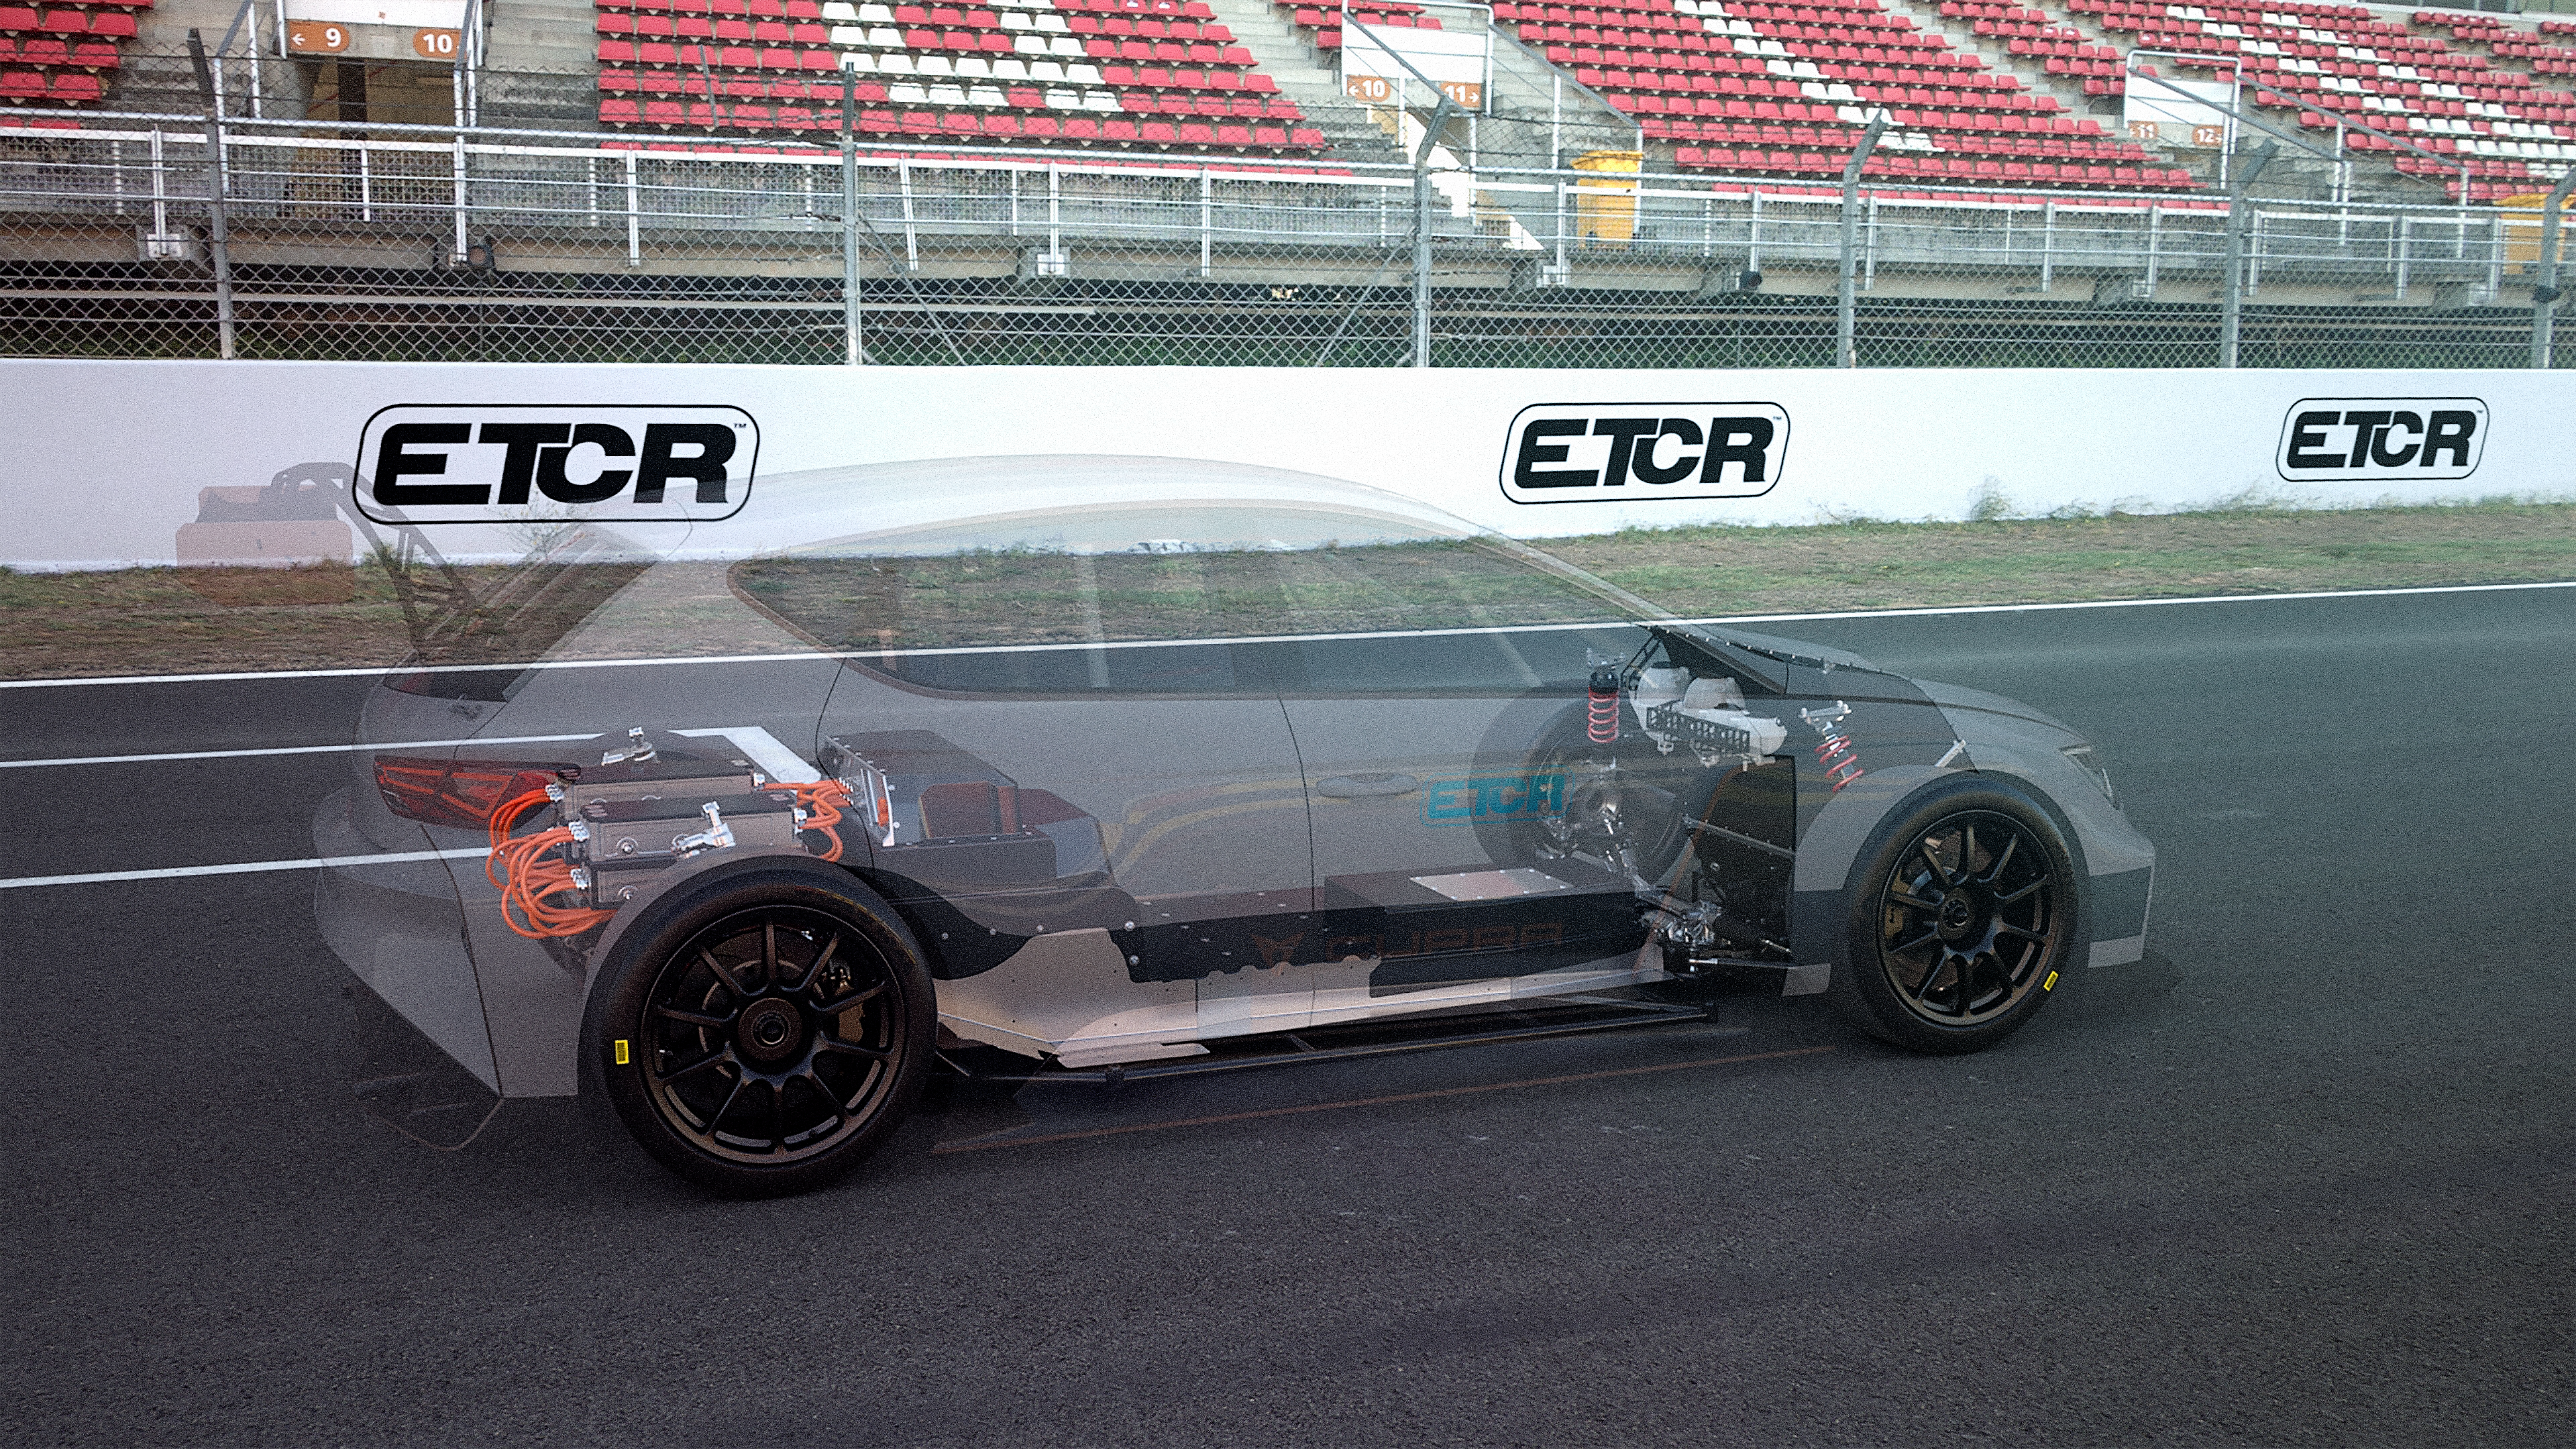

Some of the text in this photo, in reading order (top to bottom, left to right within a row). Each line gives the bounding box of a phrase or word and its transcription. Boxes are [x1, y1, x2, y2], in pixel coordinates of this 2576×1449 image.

[325, 28, 341, 47] 9
[423, 34, 453, 54] 10
[1362, 80, 1385, 97] 10
[1445, 85, 1466, 102] 11
[2138, 123, 2154, 138] 11
[2197, 128, 2215, 143] 12
[2286, 410, 2477, 469] ETCR
[1514, 417, 1774, 489] ETCR
[372, 422, 737, 506] ETCR
[1427, 775, 1566, 819] ETCR
